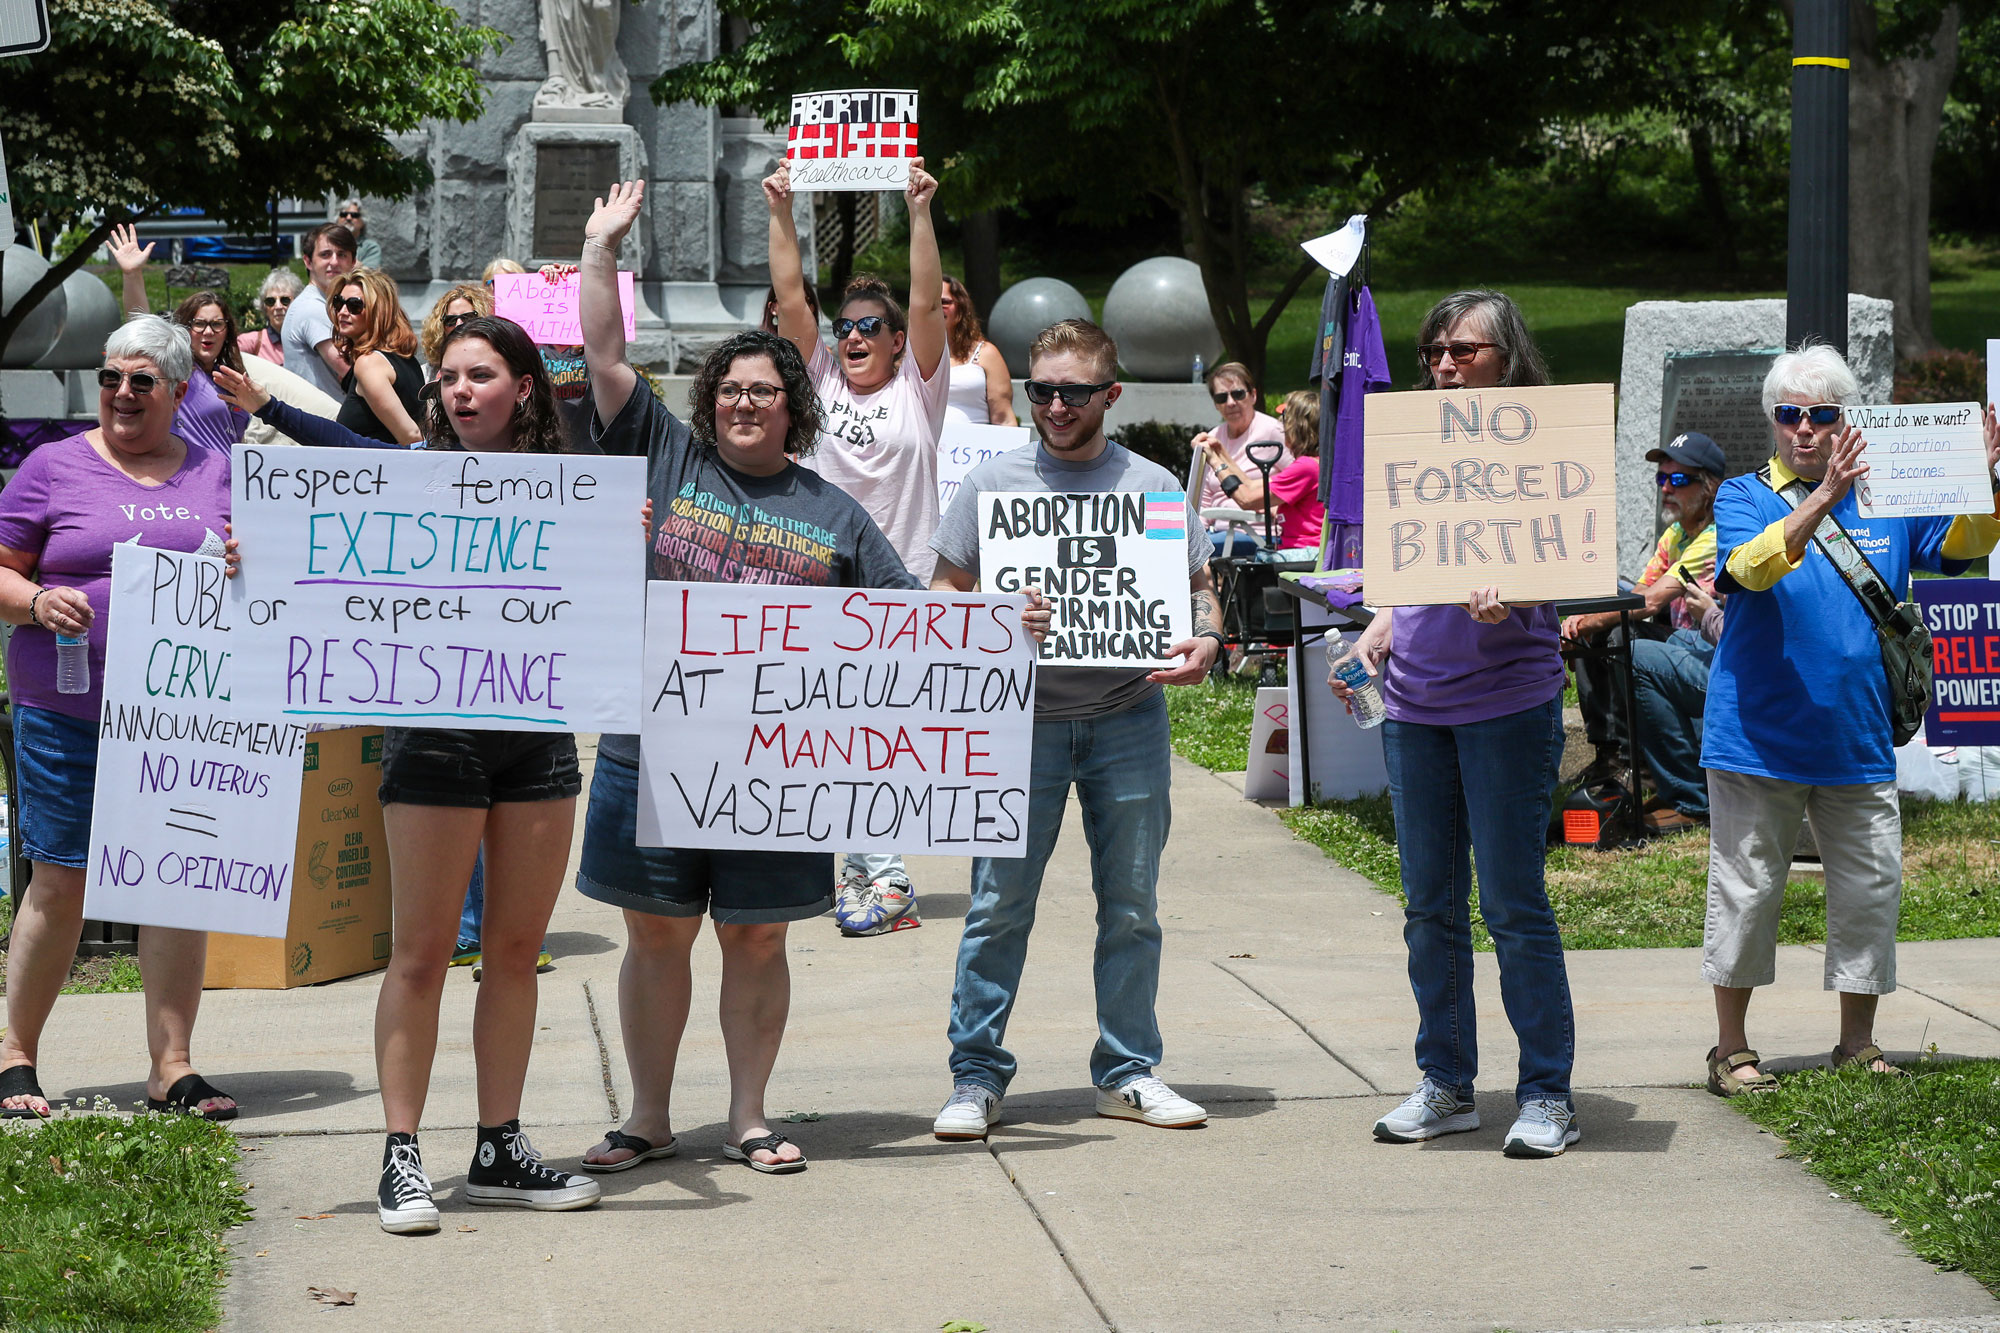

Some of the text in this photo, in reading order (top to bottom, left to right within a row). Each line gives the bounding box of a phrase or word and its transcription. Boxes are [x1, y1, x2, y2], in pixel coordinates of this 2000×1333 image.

[790, 93, 918, 126] ABORTION
[792, 160, 909, 183] healthcare
[507, 279, 581, 299] Aborti
[543, 302, 568, 314] IS
[1439, 394, 1537, 445] NO
[1848, 408, 1971, 428] What do we want?
[1889, 434, 1951, 454] abortion
[244, 449, 597, 509] Respect female
[1385, 457, 1595, 509] FORCED
[1891, 460, 1945, 480] becomes
[118, 503, 201, 521] Vote.
[988, 493, 1145, 540] ABORTION
[1885, 486, 1970, 508] constitutionally
[307, 511, 556, 576] EXISTENCE
[659, 514, 728, 554] ABORTION
[728, 541, 744, 562] IS
[670, 497, 837, 567] ABORTION IS HEALTHCARE
[739, 503, 750, 524] IS
[753, 506, 838, 548] HEALTHCARE
[1388, 508, 1597, 572] BIRTH!
[655, 533, 722, 573] ABORTION
[721, 558, 739, 581] IS
[1069, 540, 1102, 564] IS
[152, 552, 231, 632] PUBL
[995, 566, 1141, 599] GENDER
[248, 595, 572, 633] or expect our
[680, 589, 1014, 656] LIFE STARTS
[1928, 603, 1979, 631] STOP
[1037, 630, 1172, 660] EALTHCARE
[287, 636, 567, 710] RESISTANCE
[652, 659, 1033, 715] AT EJACULATION
[101, 700, 307, 757] ANNOUNCEMENT:
[745, 722, 998, 777] MANDATE
[139, 751, 271, 798] NO UTERUS
[331, 783, 350, 792] DART
[670, 761, 1026, 847] VASECTOMIES
[344, 831, 363, 847] CLEAR
[99, 844, 289, 901] NO OPINION
[336, 861, 372, 880] CONTAINERS
